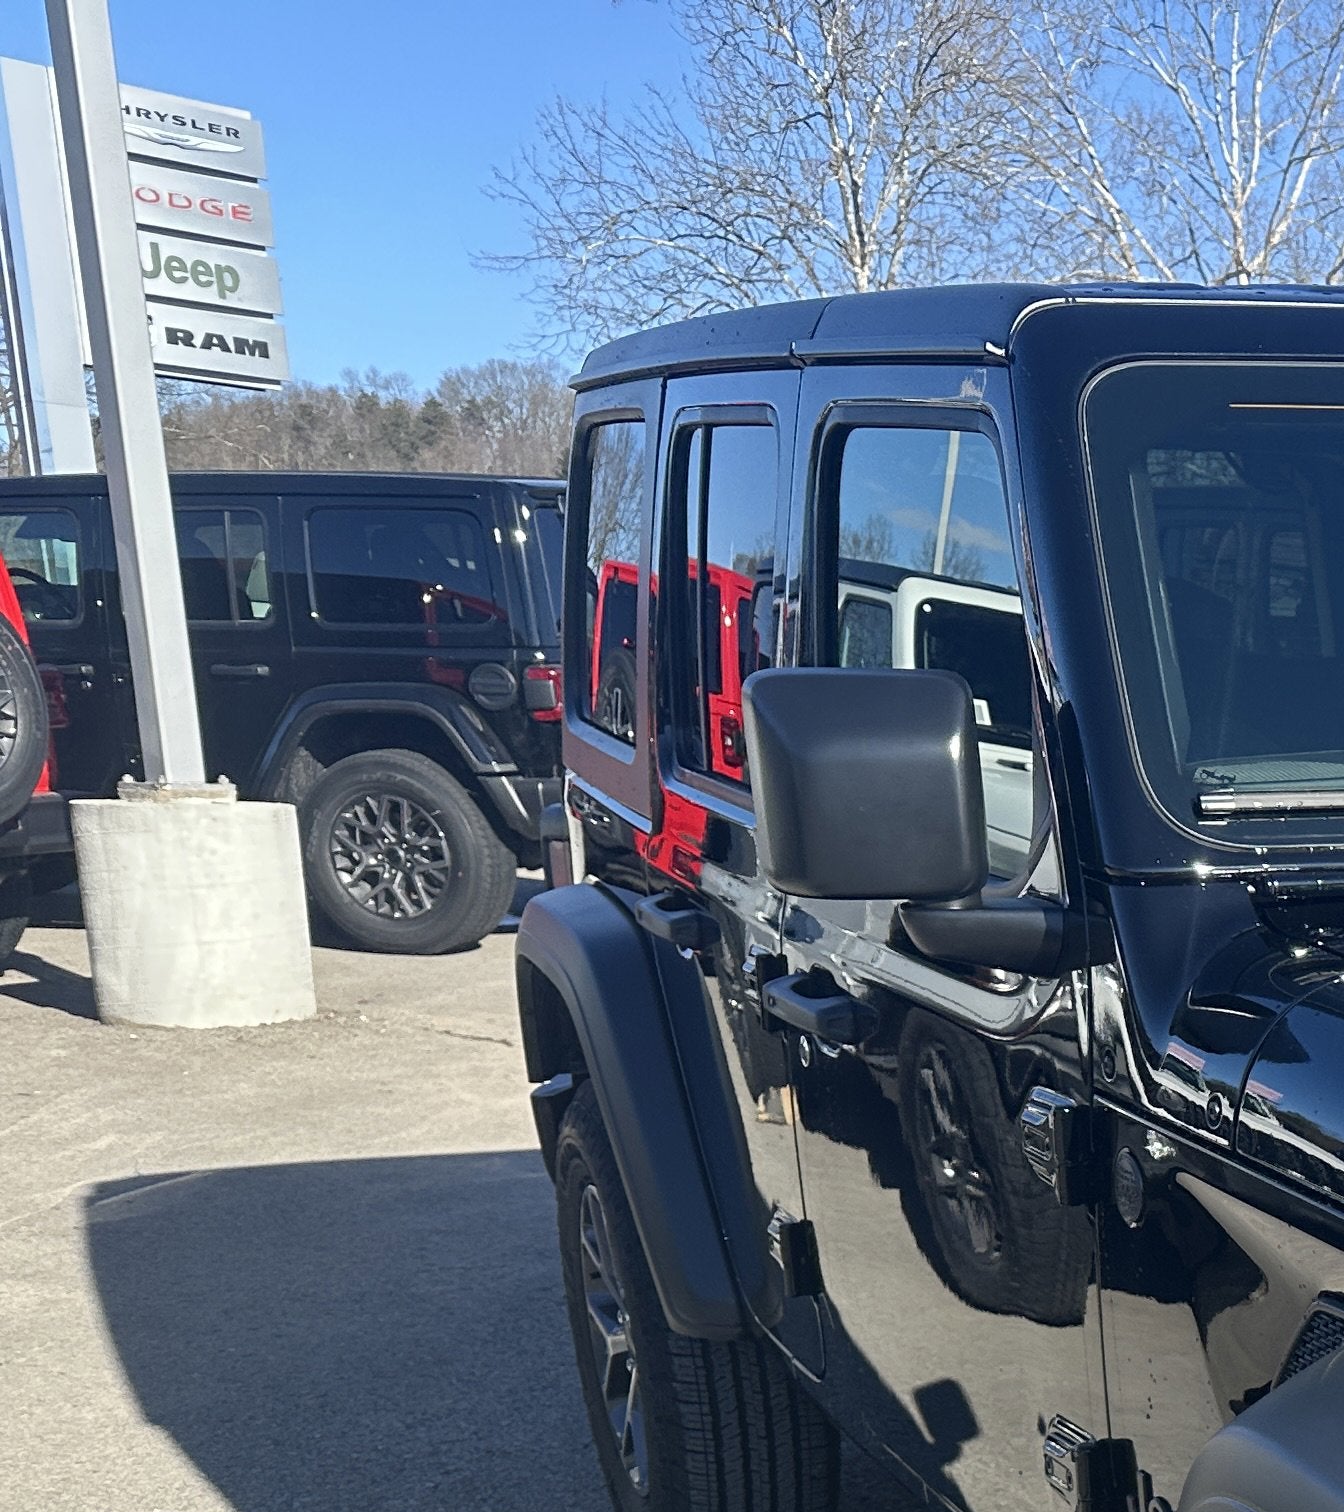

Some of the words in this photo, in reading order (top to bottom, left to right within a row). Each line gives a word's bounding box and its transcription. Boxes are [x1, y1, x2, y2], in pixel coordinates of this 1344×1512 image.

[121, 105, 241, 139] HRYSLER
[134, 187, 252, 222] ODGE
[142, 242, 240, 300] Jeep
[164, 326, 270, 359] RAM
